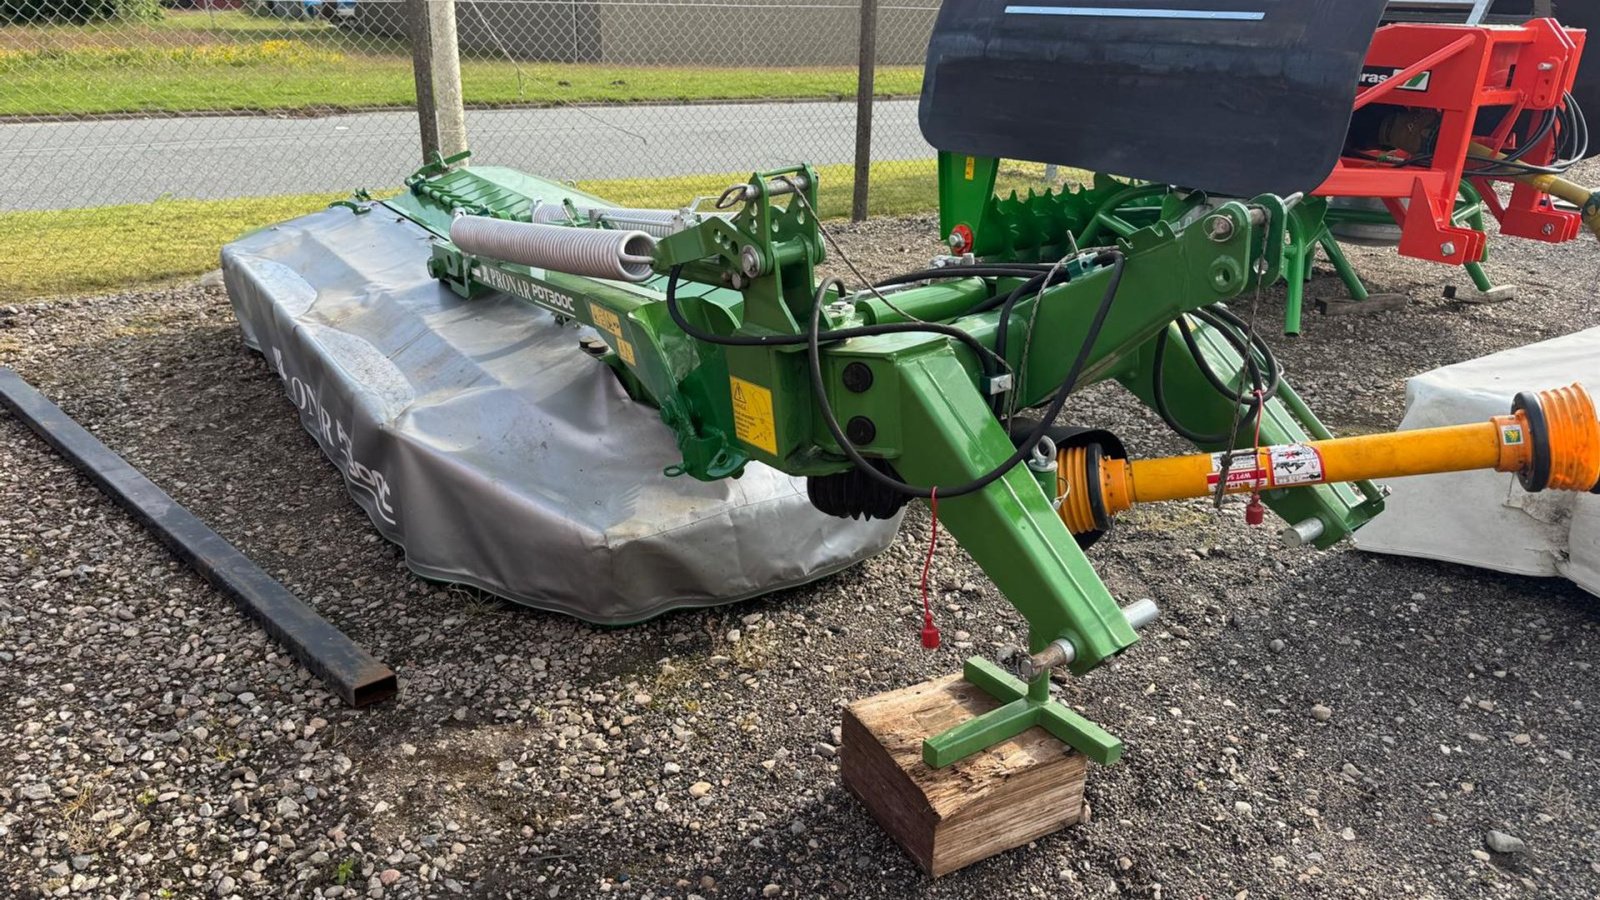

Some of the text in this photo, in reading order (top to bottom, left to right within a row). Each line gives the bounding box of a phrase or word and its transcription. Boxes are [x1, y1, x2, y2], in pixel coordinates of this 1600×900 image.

[1358, 73, 1388, 83] ras
[489, 268, 575, 312] PRONAR PDT300C
